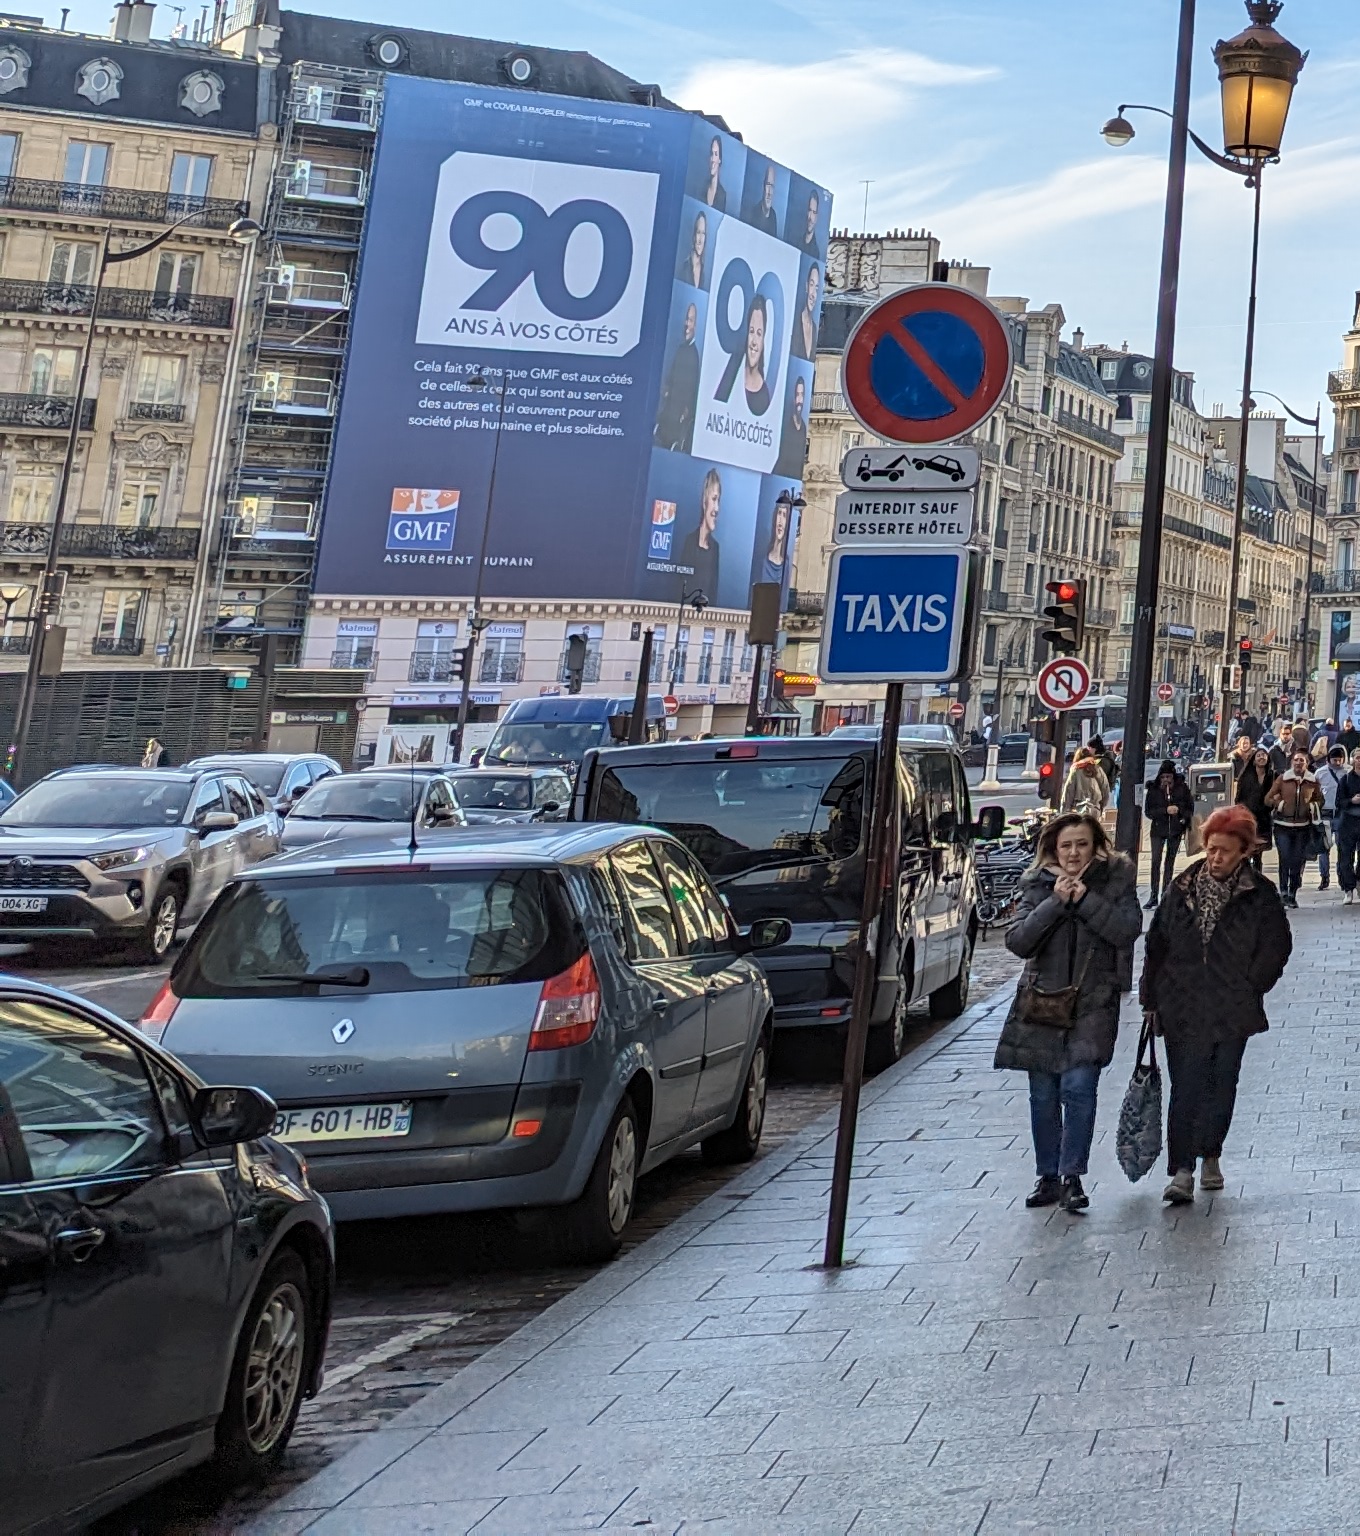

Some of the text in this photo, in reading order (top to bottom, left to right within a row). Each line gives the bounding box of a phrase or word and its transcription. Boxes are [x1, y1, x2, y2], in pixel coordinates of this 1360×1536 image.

[463, 97, 483, 107] GMF
[484, 101, 492, 109] et
[450, 191, 633, 321] 90
[444, 317, 619, 345] ANS À VOS CÔTÉS
[713, 257, 785, 416] 90
[414, 360, 633, 386] Cela fait 90 ans que GMF est aux côtés
[420, 379, 437, 392] de
[439, 380, 473, 393] celles
[519, 387, 538, 399] qui
[540, 388, 564, 399] sont
[567, 390, 581, 400] au
[583, 390, 623, 402] service
[418, 397, 441, 410] des
[443, 400, 479, 411] autres
[481, 402, 494, 413] et
[568, 408, 596, 420] pour
[598, 409, 620, 419] une
[408, 415, 452, 428] société
[454, 417, 479, 431] plus
[481, 418, 532, 433] humaine
[534, 423, 546, 434] et
[548, 423, 572, 436] plus
[705, 412, 724, 434] ANS
[731, 419, 747, 440] VOS
[747, 421, 773, 447] CÔTÉS
[849, 503, 959, 515] INTERDIT SAUF
[394, 520, 450, 541] GMF
[838, 520, 964, 535] DESSERTE HÔTEL
[383, 554, 474, 566] ASSURÉMENT
[842, 594, 947, 633] TAXIS
